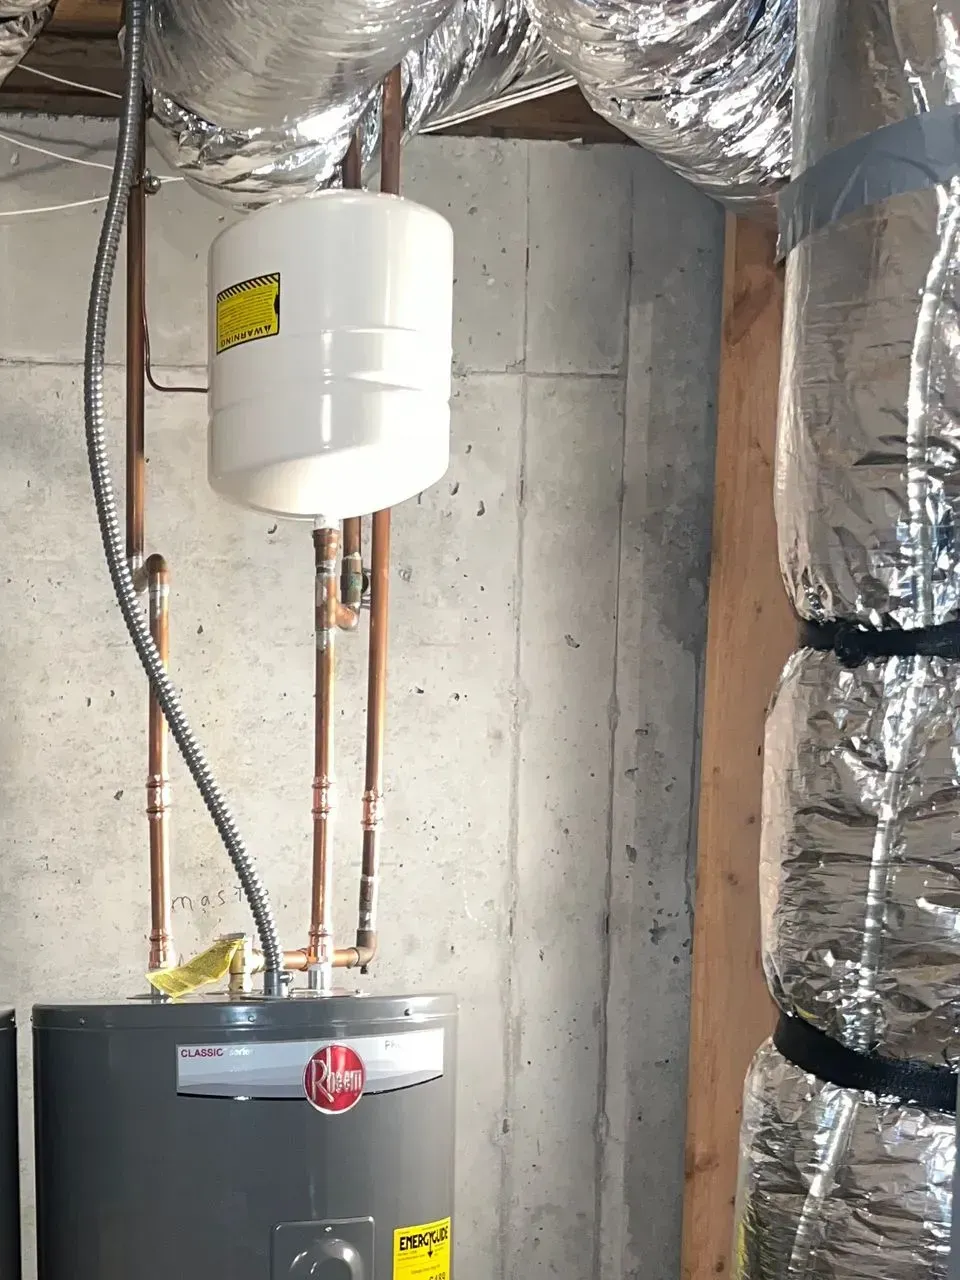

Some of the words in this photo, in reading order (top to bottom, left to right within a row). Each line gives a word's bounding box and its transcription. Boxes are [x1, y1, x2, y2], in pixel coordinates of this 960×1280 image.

[220, 327, 263, 347] WARNING
[181, 1048, 224, 1058] CLASSIC
[311, 1047, 362, 1103] Rheem
